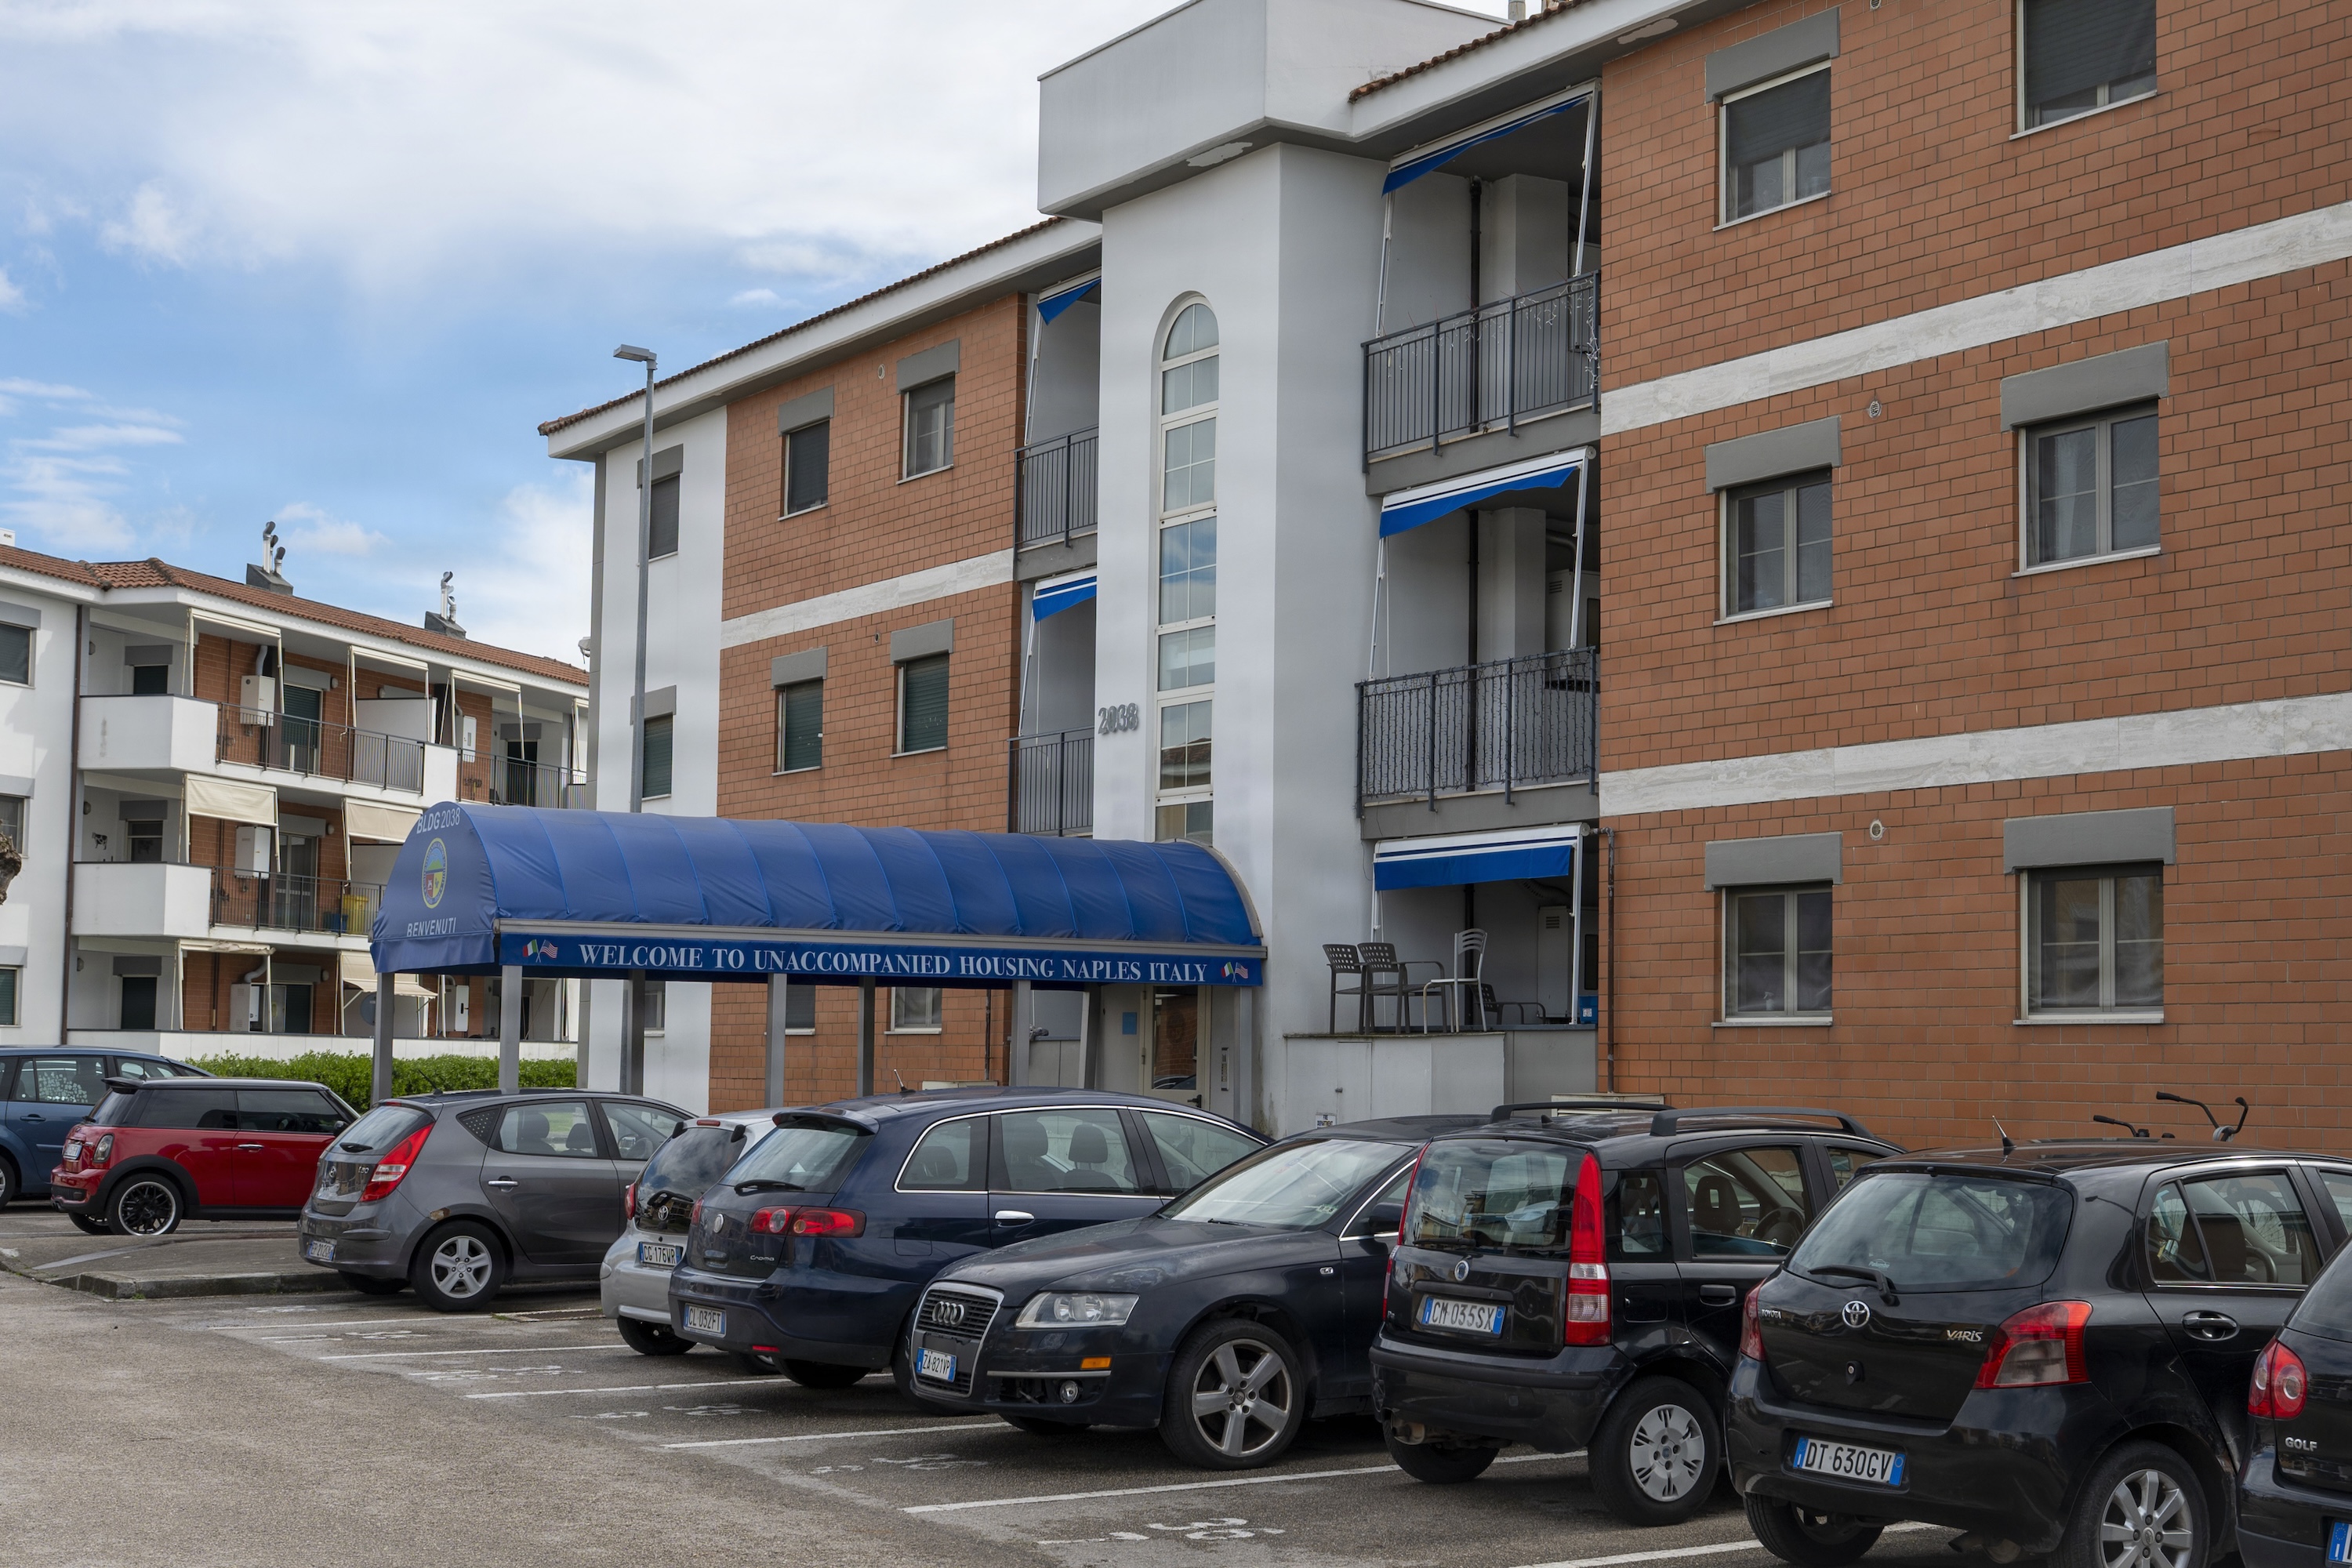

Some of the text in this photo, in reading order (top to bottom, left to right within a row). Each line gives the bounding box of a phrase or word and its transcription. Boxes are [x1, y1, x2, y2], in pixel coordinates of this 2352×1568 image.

[1098, 702, 1138, 735] 2038
[416, 808, 461, 834] BLDG 2038
[407, 916, 456, 937] BENVENUTI
[579, 945, 1207, 982] WELCOME TO UNACCOMPANIED HOUSING NAPLES ITALY
[644, 1246, 676, 1264] CG 176WR
[688, 1308, 697, 1327] CL
[699, 1309, 721, 1331] 032FT
[1432, 1301, 1448, 1324] CM
[1450, 1302, 1496, 1330] 035SX
[1761, 1308, 1782, 1319] TOYOTA
[923, 1354, 931, 1371] ZA
[932, 1356, 951, 1375] 821VP
[2285, 1436, 2318, 1452] GOLF
[1805, 1441, 1829, 1470] DT
[1832, 1446, 1893, 1480] 630GV
